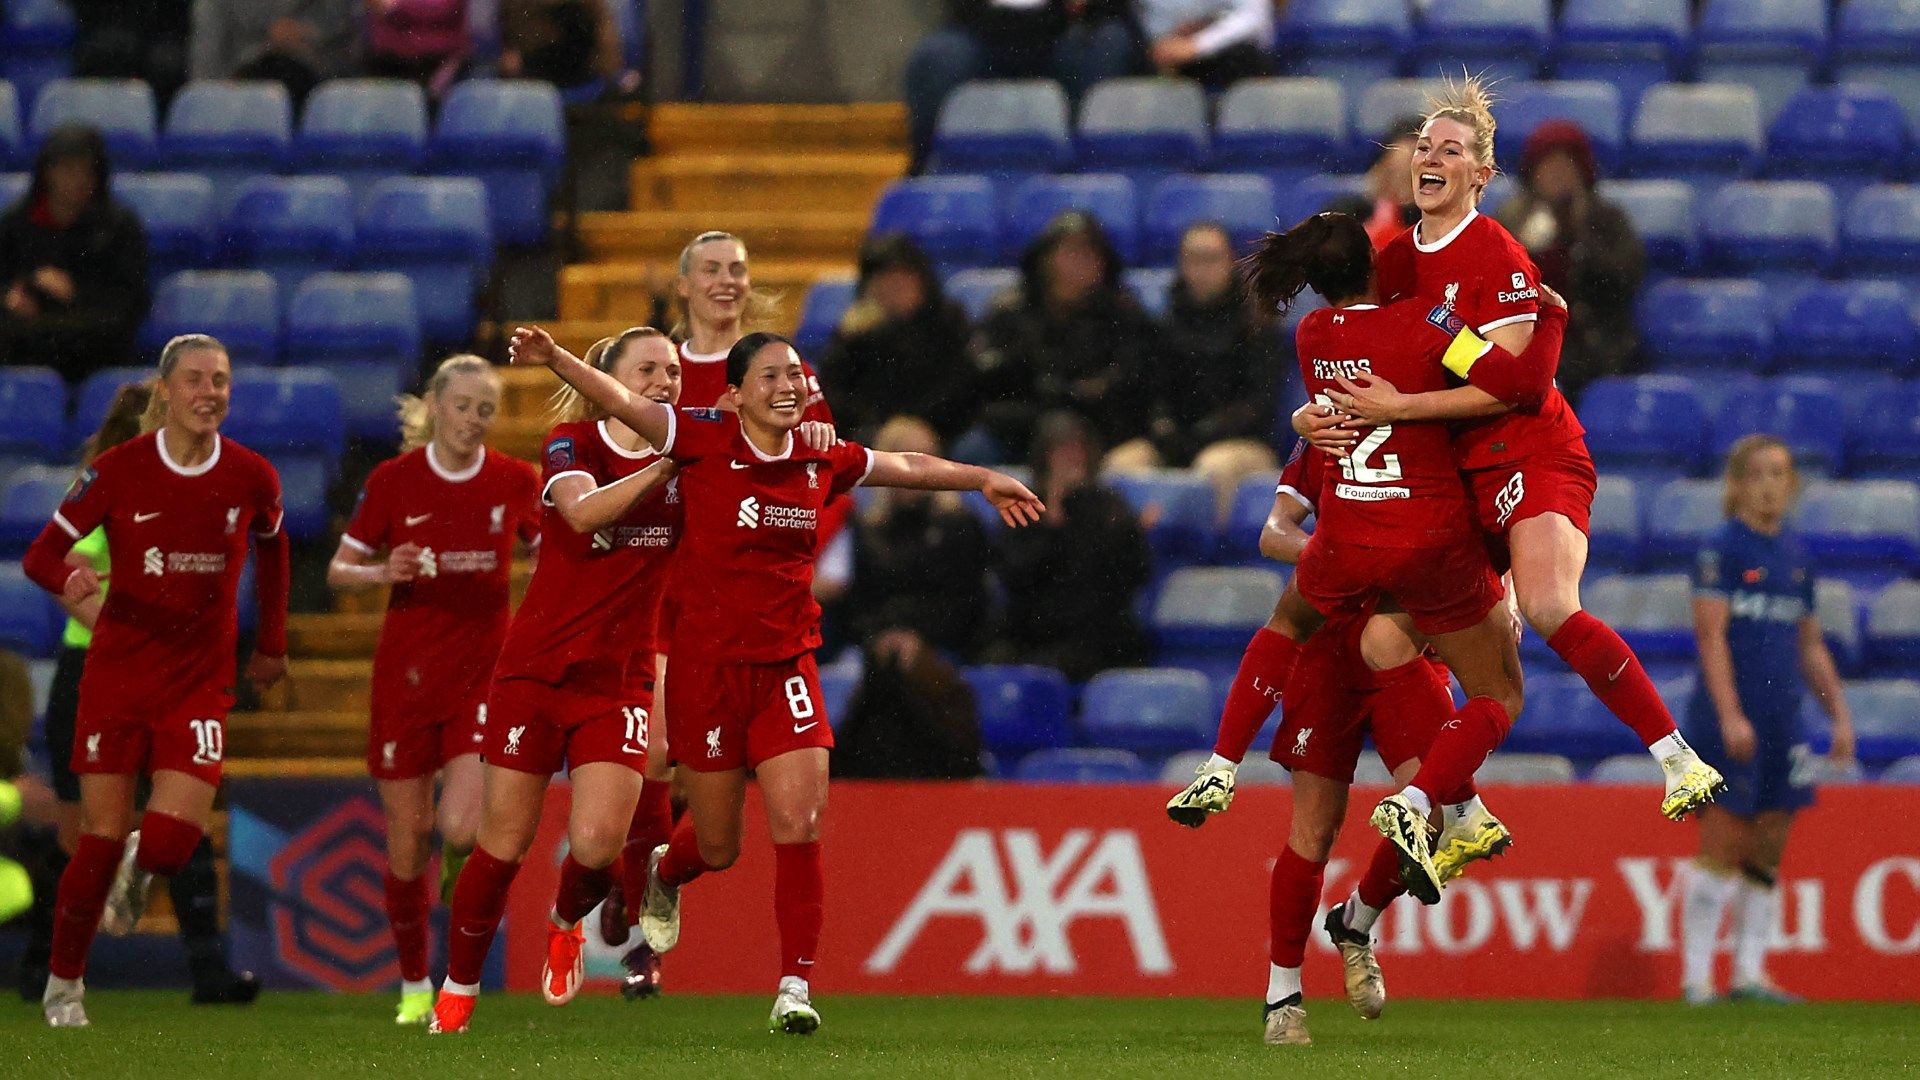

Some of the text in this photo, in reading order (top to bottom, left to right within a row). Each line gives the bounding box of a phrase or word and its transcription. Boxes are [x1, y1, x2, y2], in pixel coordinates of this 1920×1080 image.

[1312, 358, 1372, 380] HINDS
[764, 504, 817, 519] standard
[1344, 486, 1407, 499] Foundation
[763, 515, 818, 530] chartered
[784, 675, 814, 719] 8
[189, 719, 223, 762] 10
[621, 705, 649, 750] 18
[863, 828, 1176, 973] AXA
[1616, 856, 1827, 952] Yu
